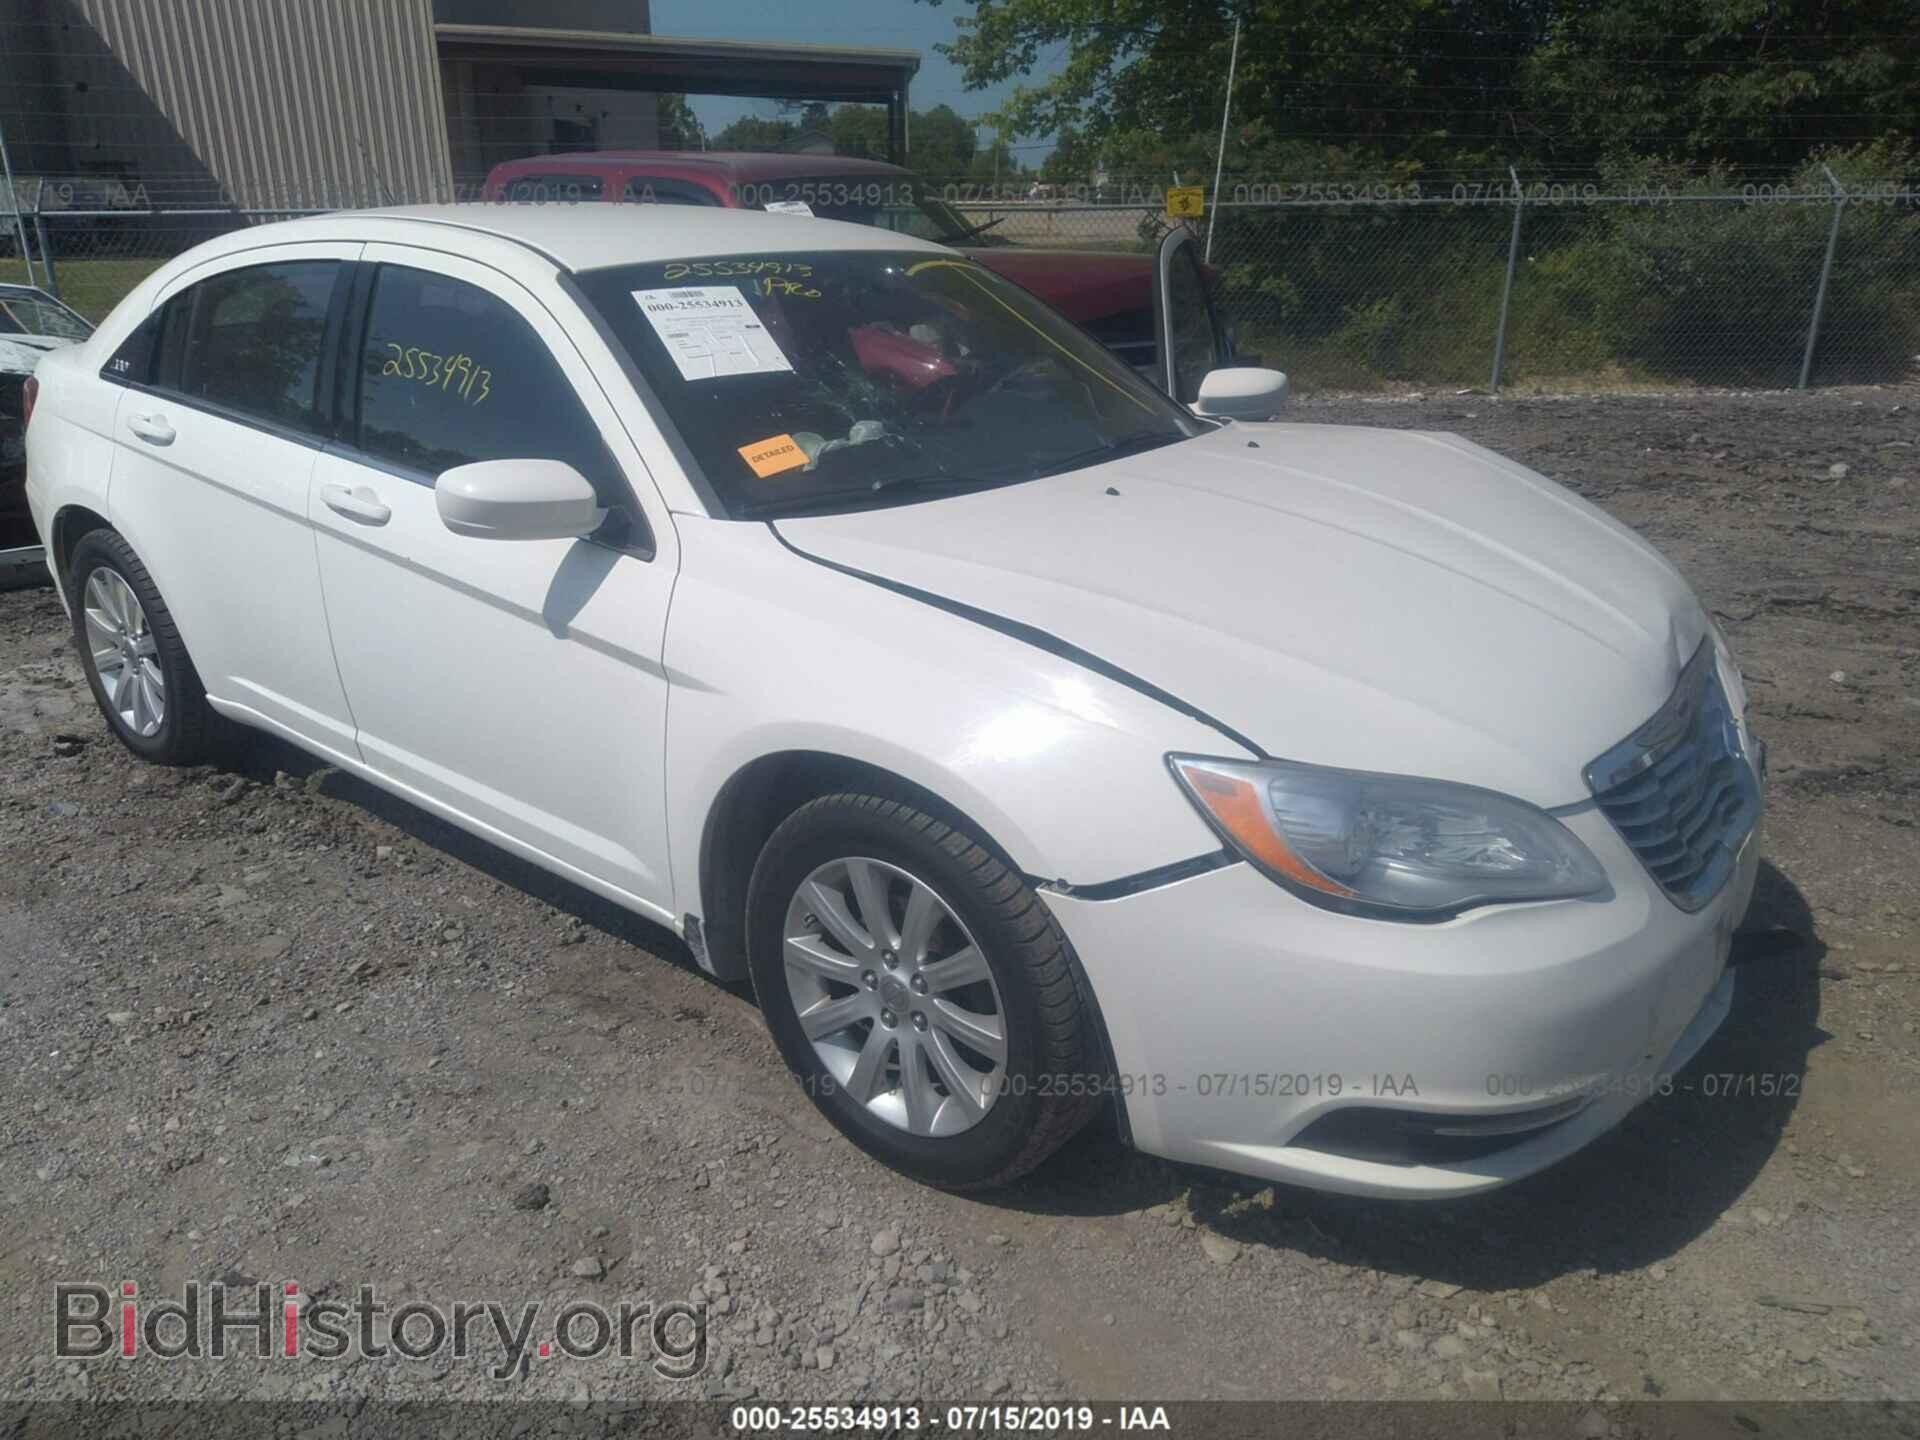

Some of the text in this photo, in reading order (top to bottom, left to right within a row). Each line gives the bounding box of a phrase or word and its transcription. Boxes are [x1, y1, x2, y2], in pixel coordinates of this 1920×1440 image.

[663, 260, 815, 280] 25534913
[646, 298, 744, 313] 000-25534913
[382, 343, 492, 406] 25534913
[751, 444, 796, 463] DETAILED
